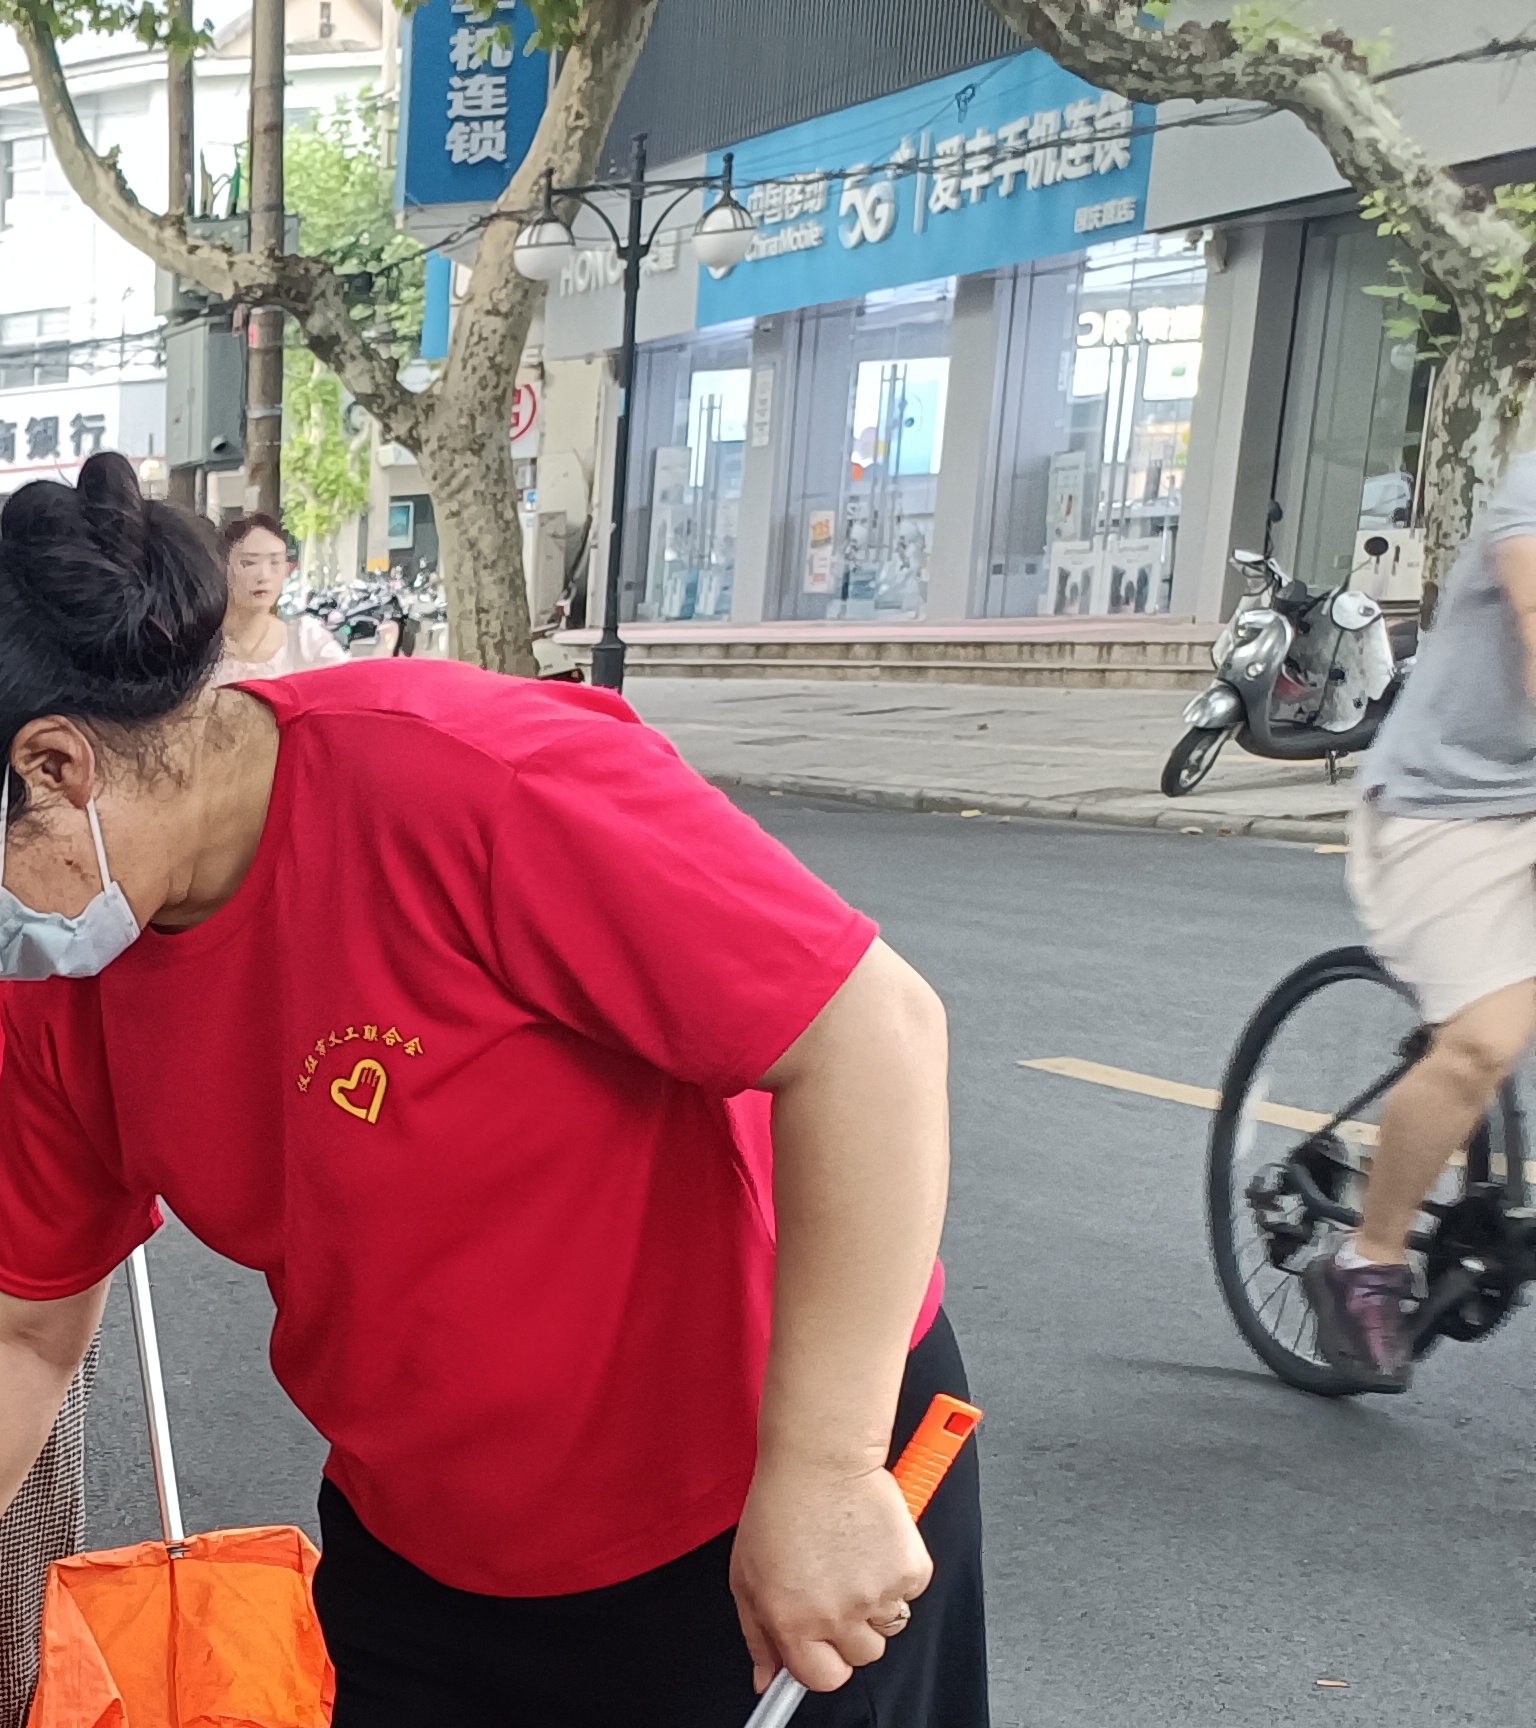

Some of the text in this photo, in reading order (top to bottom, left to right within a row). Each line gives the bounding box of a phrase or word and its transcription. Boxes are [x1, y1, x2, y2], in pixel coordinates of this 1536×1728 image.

[747, 166, 827, 226] 中国移动
[560, 242, 628, 297] HONO
